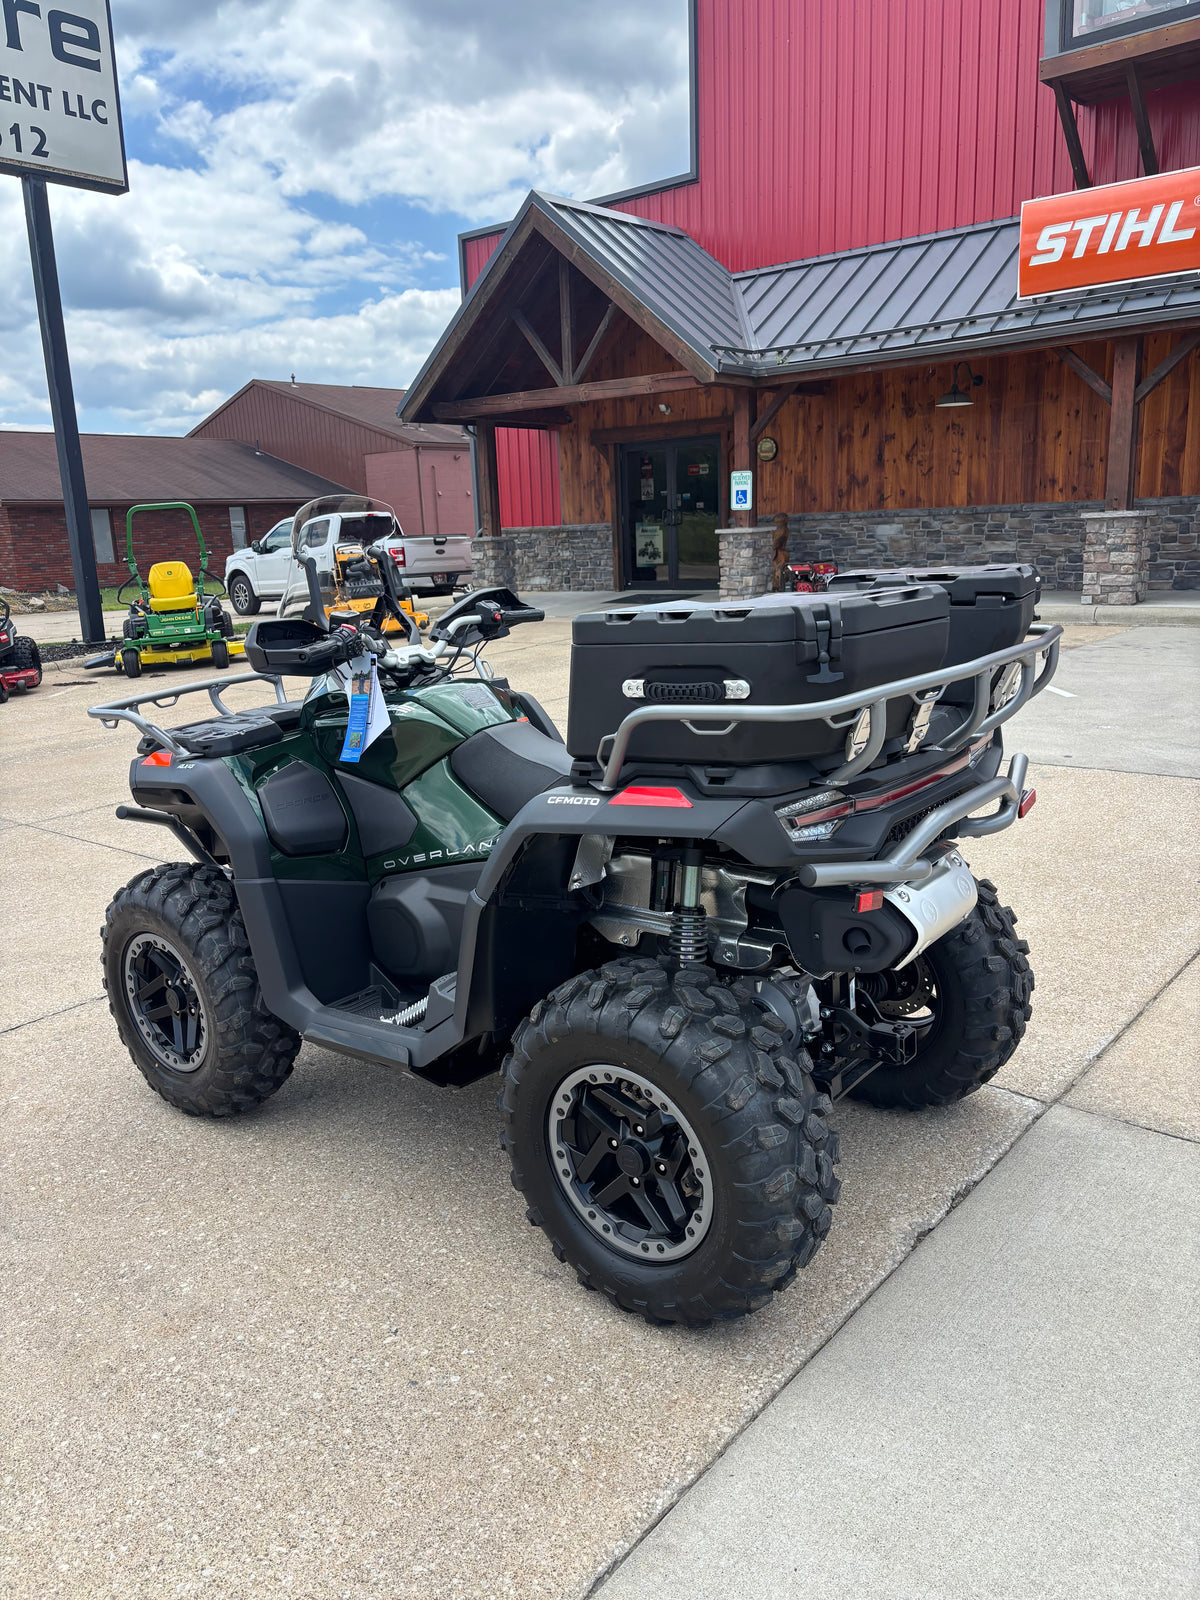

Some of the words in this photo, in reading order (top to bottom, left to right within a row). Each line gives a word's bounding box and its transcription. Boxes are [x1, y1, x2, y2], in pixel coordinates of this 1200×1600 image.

[2, 0, 102, 73] re
[62, 90, 108, 125] LLC
[0, 122, 50, 158] 12
[1028, 200, 1196, 267] STIHL
[547, 796, 600, 806] CFMOTO
[383, 838, 500, 869] OVERLAN
